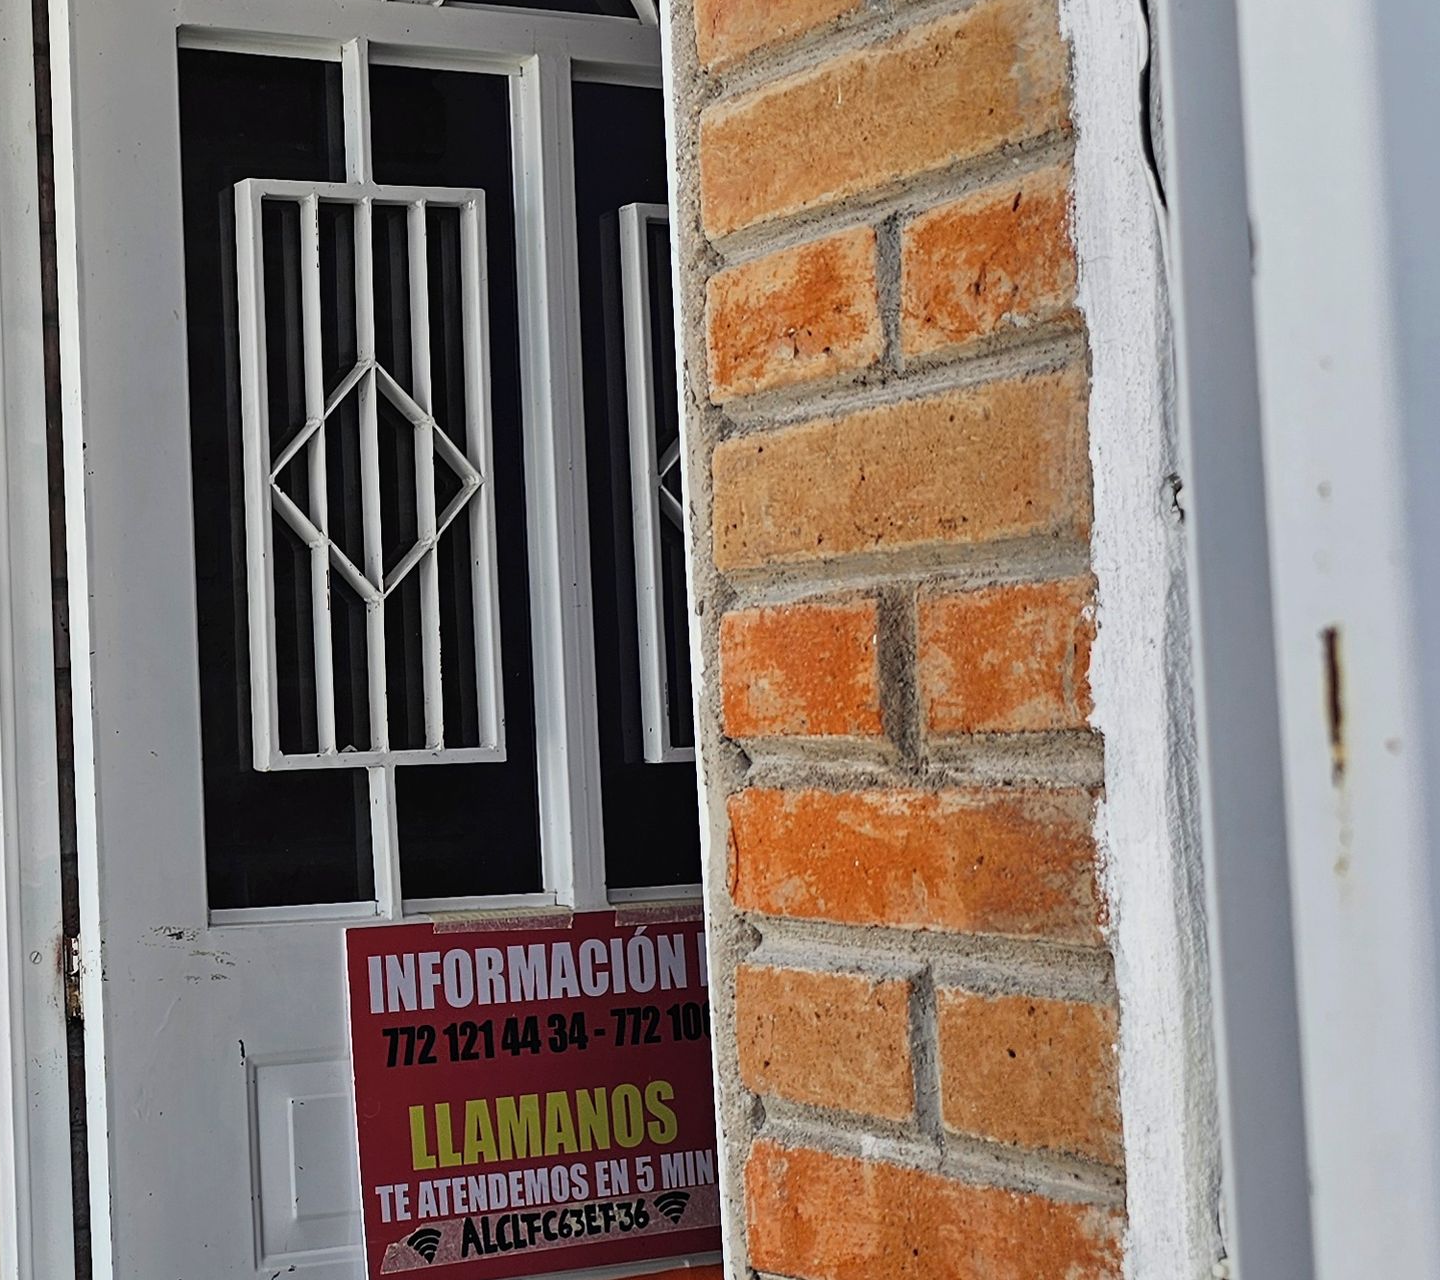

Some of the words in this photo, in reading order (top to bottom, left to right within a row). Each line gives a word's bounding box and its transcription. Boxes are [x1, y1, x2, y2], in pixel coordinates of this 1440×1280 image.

[367, 926, 687, 1014] INFORMACIÓN
[383, 1024, 437, 1067] 772
[443, 1020, 495, 1063] 121
[501, 1016, 542, 1056] 44
[548, 1012, 588, 1053] 34
[610, 1006, 660, 1046] 772
[408, 1080, 679, 1171] LLAMANOS
[375, 1183, 411, 1223] TE
[417, 1164, 589, 1219] ATENDEMOS
[596, 1160, 630, 1198] EN
[637, 1155, 656, 1191] 5
[660, 1149, 713, 1188] MIN
